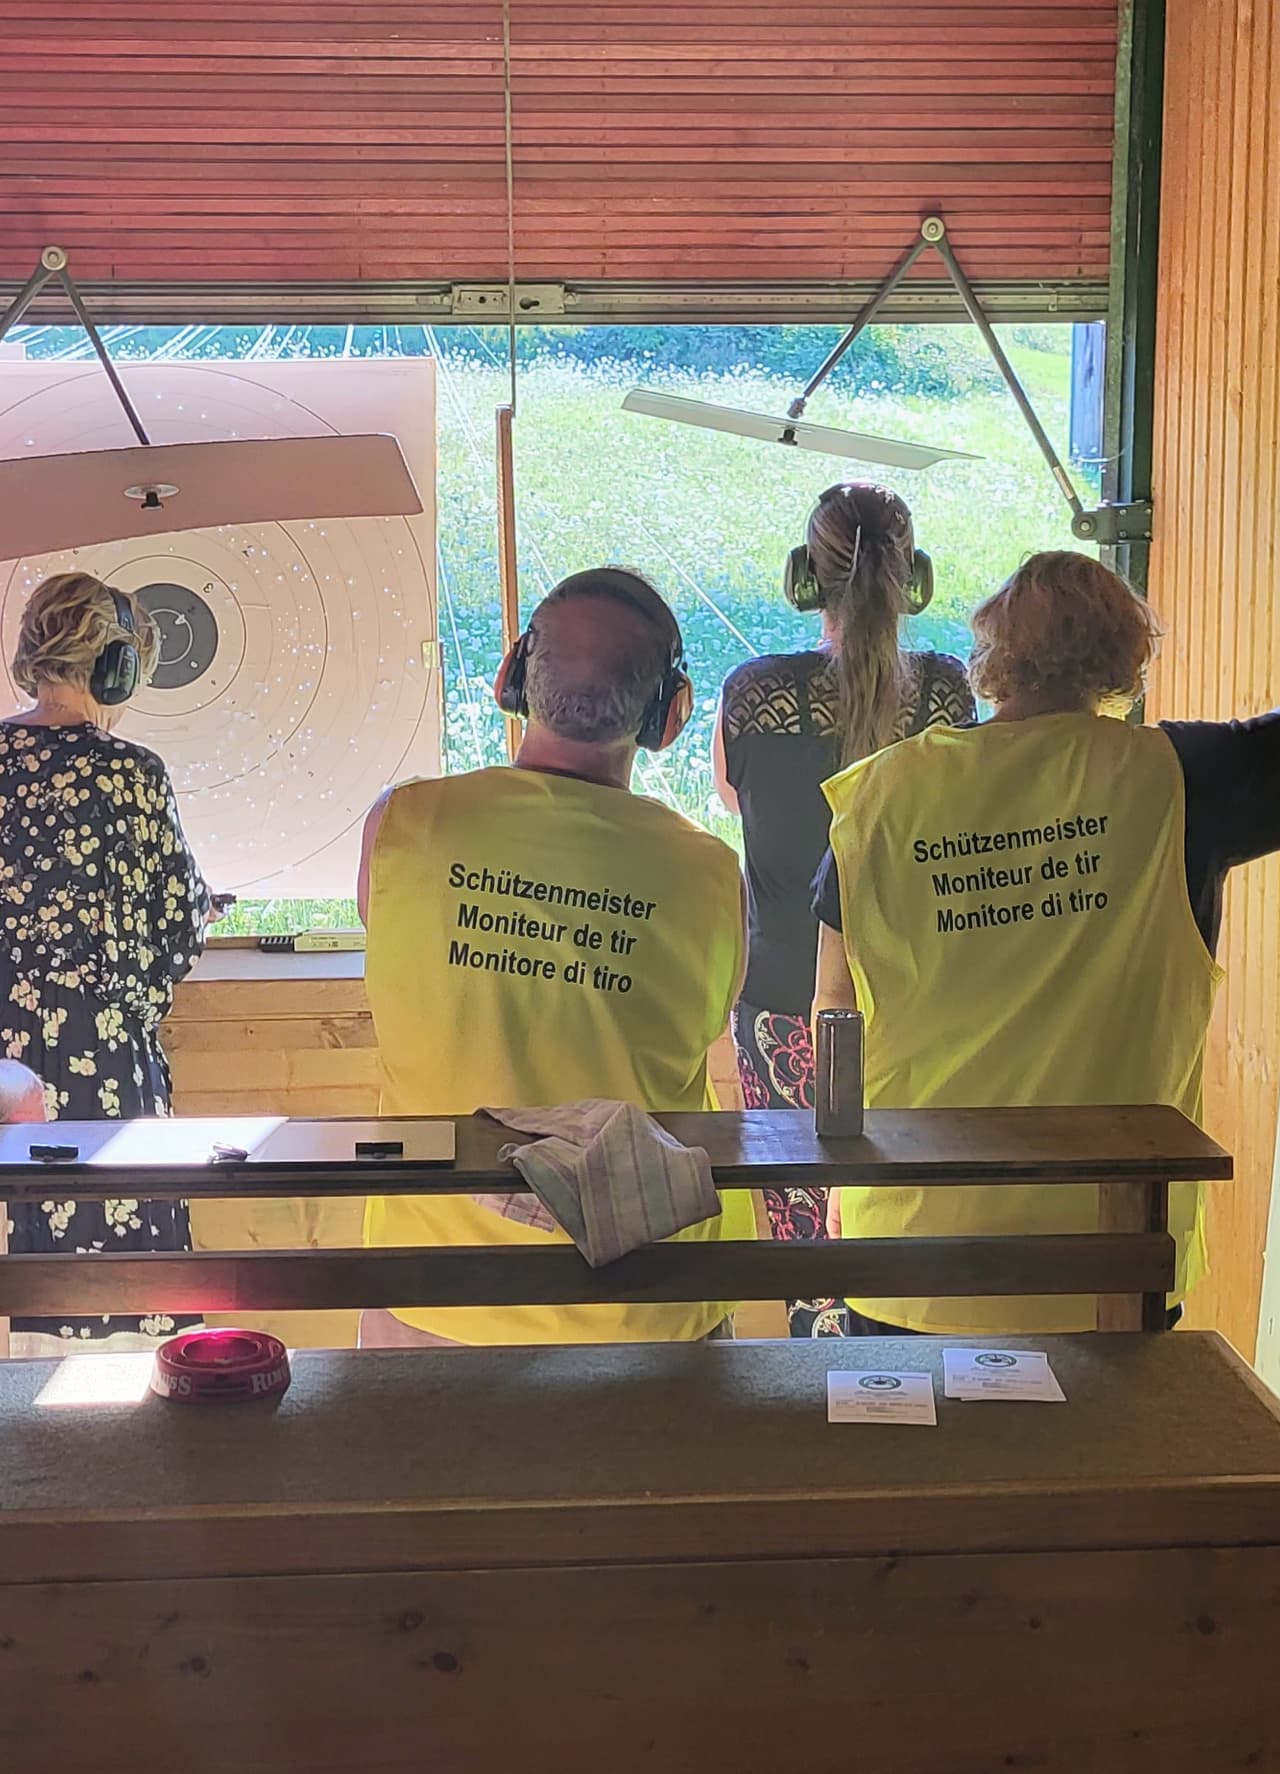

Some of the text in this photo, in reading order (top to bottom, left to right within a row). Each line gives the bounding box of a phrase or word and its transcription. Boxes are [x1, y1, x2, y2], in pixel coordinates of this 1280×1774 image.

[913, 815, 1108, 864] Schützenmeister
[448, 863, 656, 920] Schützenmeister
[932, 850, 1101, 897] Moniteur de tir
[457, 903, 637, 955] Moniteur de tir
[937, 889, 1108, 933] Monitore di tiro
[448, 940, 633, 993] Monitore di tiro
